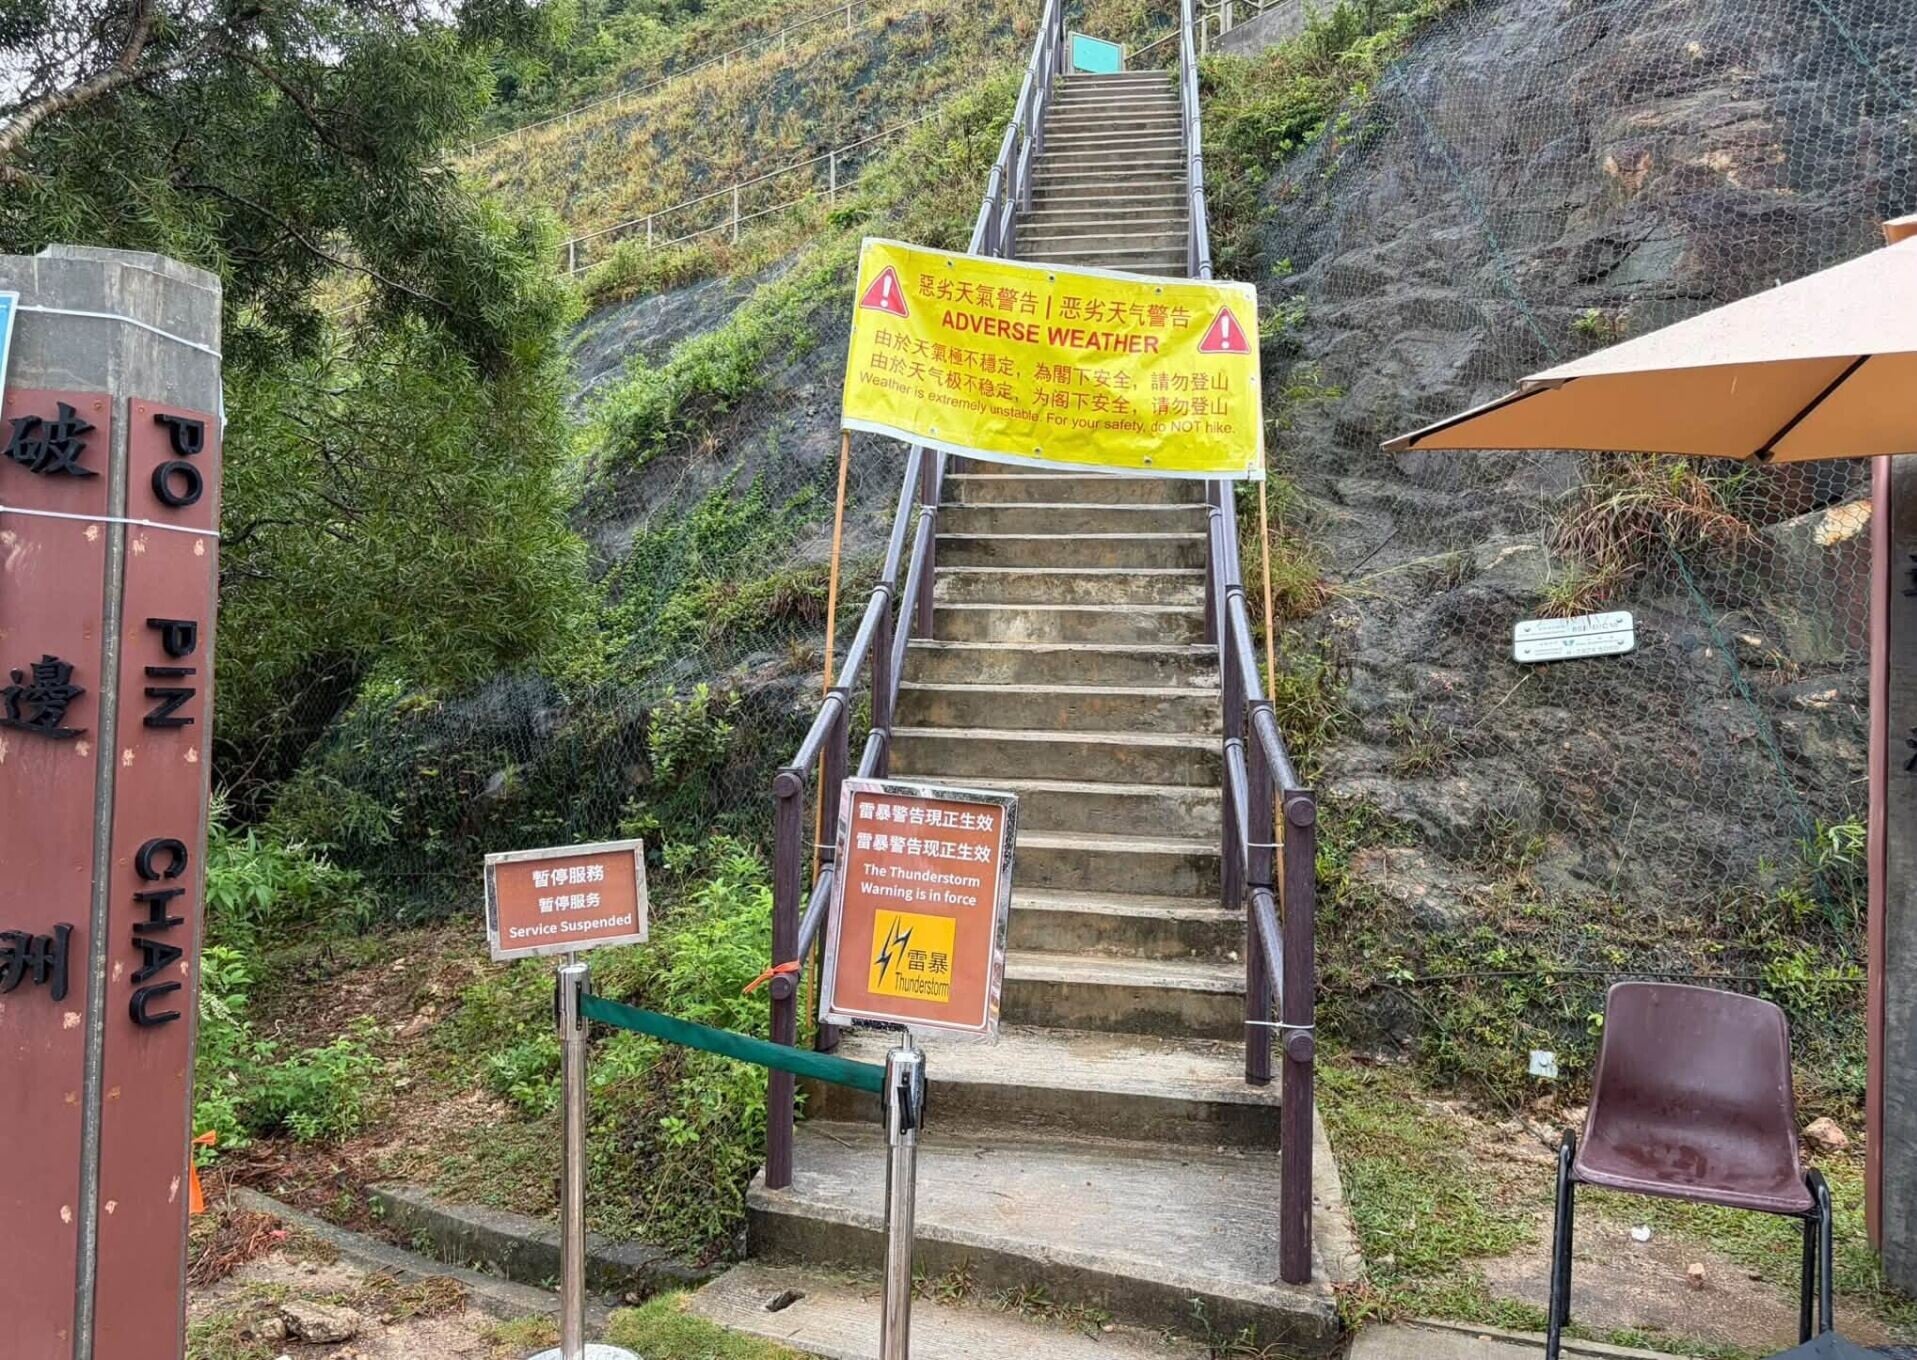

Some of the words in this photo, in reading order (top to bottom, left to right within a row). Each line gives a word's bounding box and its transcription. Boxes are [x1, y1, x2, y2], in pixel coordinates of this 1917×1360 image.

[919, 273, 1039, 316] 惡劣天氣警告
[1059, 295, 1191, 329] 恶劣天气警告
[942, 310, 1041, 343] ADVERSE
[1048, 326, 1159, 354] WEATHER
[859, 371, 912, 395] Weather
[914, 386, 925, 399] is
[927, 390, 987, 416] extremely
[990, 404, 1043, 423] unstable.
[1046, 413, 1068, 425] For
[1072, 418, 1101, 430] your
[1104, 420, 1146, 434] safety,
[1151, 420, 1167, 433] do
[1170, 420, 1203, 433] NOT
[1205, 421, 1236, 434] hike.
[152, 413, 205, 507] PO
[142, 617, 198, 728] PIN
[859, 802, 994, 832] 雷暴警告現正生效
[856, 832, 992, 864] 雷暴警告现正生效
[532, 864, 604, 888] 暫停服務
[864, 863, 887, 877] The
[890, 866, 981, 888] Thunderstorm
[861, 881, 913, 901] Warning
[916, 888, 926, 901] is
[930, 889, 941, 902] in
[944, 890, 977, 906] force
[128, 837, 189, 1027] CHAU
[509, 922, 558, 939] Service
[560, 913, 632, 933] Suspended
[907, 949, 949, 975] 雷暴
[895, 971, 949, 997] Thunderstorm
